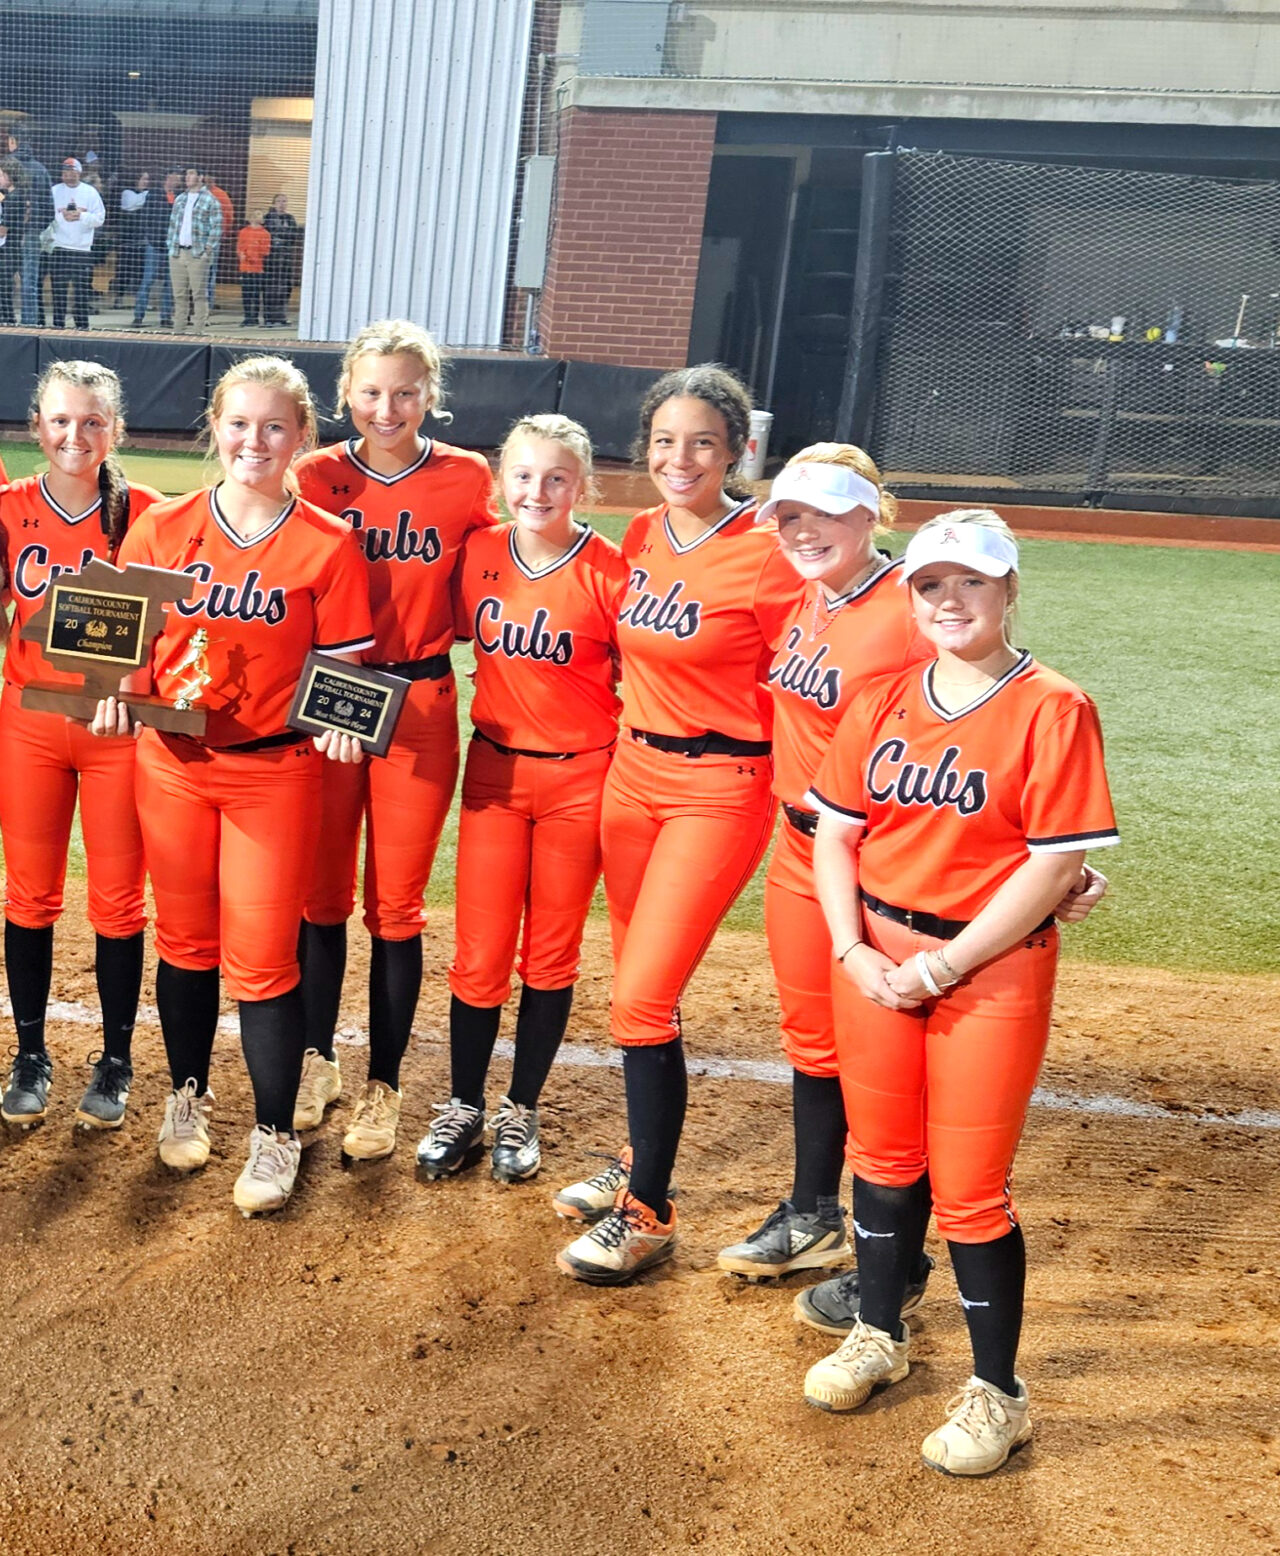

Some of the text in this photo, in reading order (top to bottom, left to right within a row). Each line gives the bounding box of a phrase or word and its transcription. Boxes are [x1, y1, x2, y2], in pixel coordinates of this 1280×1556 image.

[175, 562, 287, 626] Cubs
[64, 618, 129, 636] 20 24
[474, 596, 575, 666] Cubs
[317, 695, 372, 719] 20 24
[867, 739, 988, 816] Cubs
